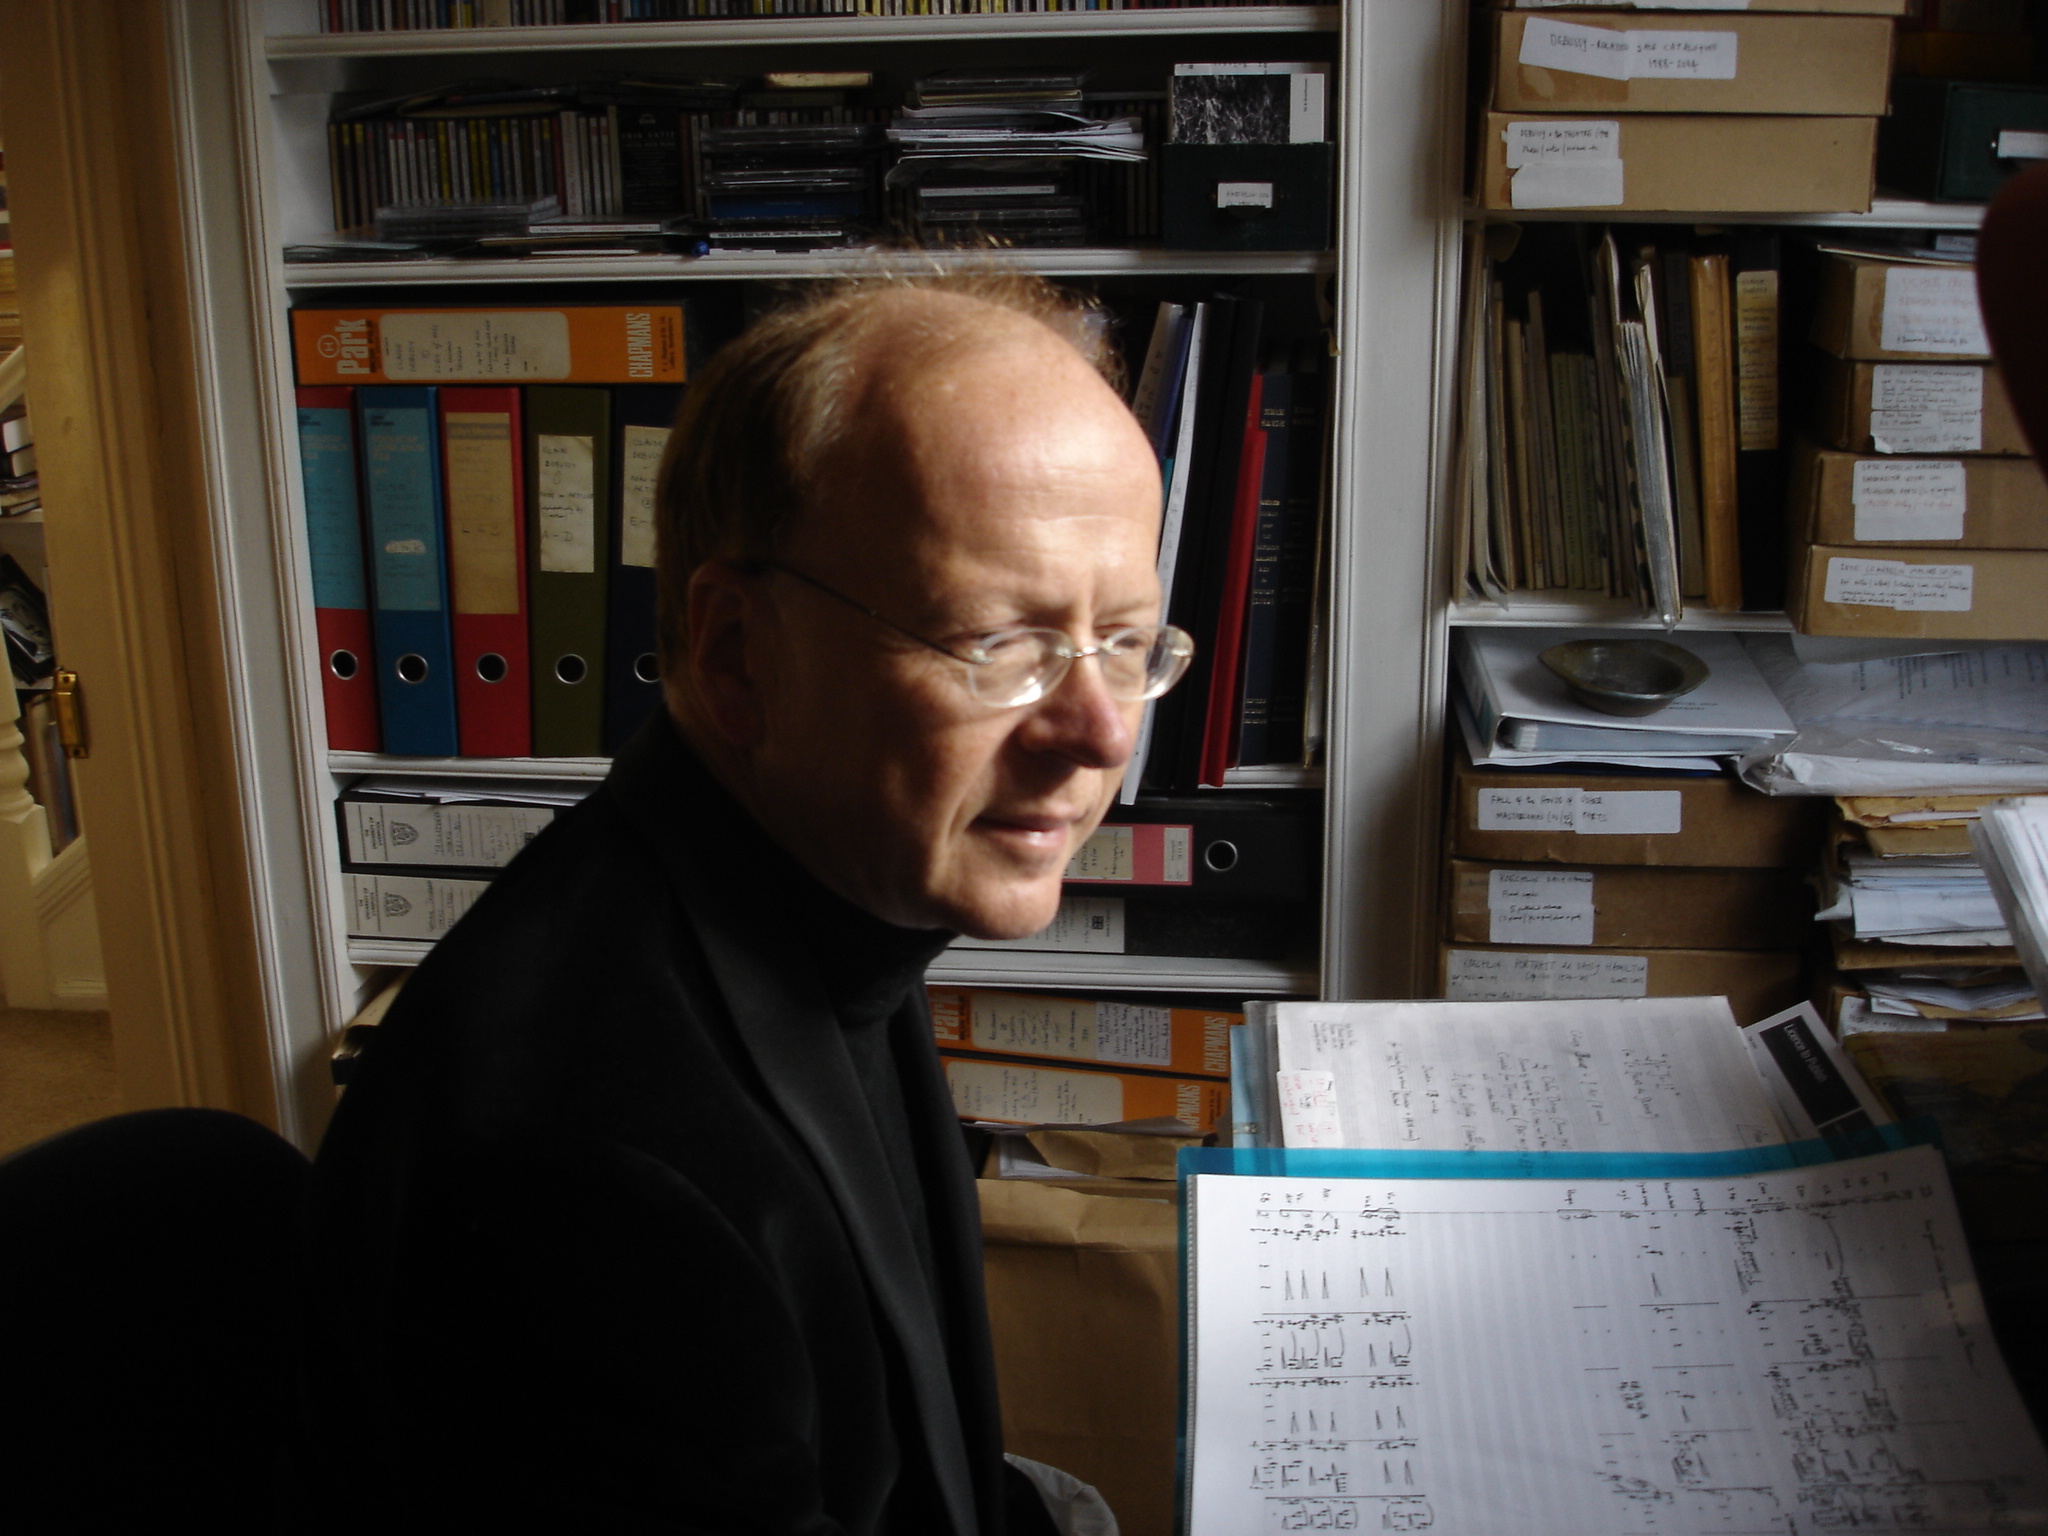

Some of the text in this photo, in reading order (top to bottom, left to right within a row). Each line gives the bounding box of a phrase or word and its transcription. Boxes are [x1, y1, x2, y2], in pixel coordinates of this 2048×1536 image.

[1550, 33, 1587, 52] DEBUSSY
[334, 318, 371, 375] Park
[625, 312, 653, 378] CHAPMANS
[929, 992, 960, 1041] Park
[1783, 1023, 1807, 1053] Licence
[1202, 1016, 1228, 1073] CHAPMANS
